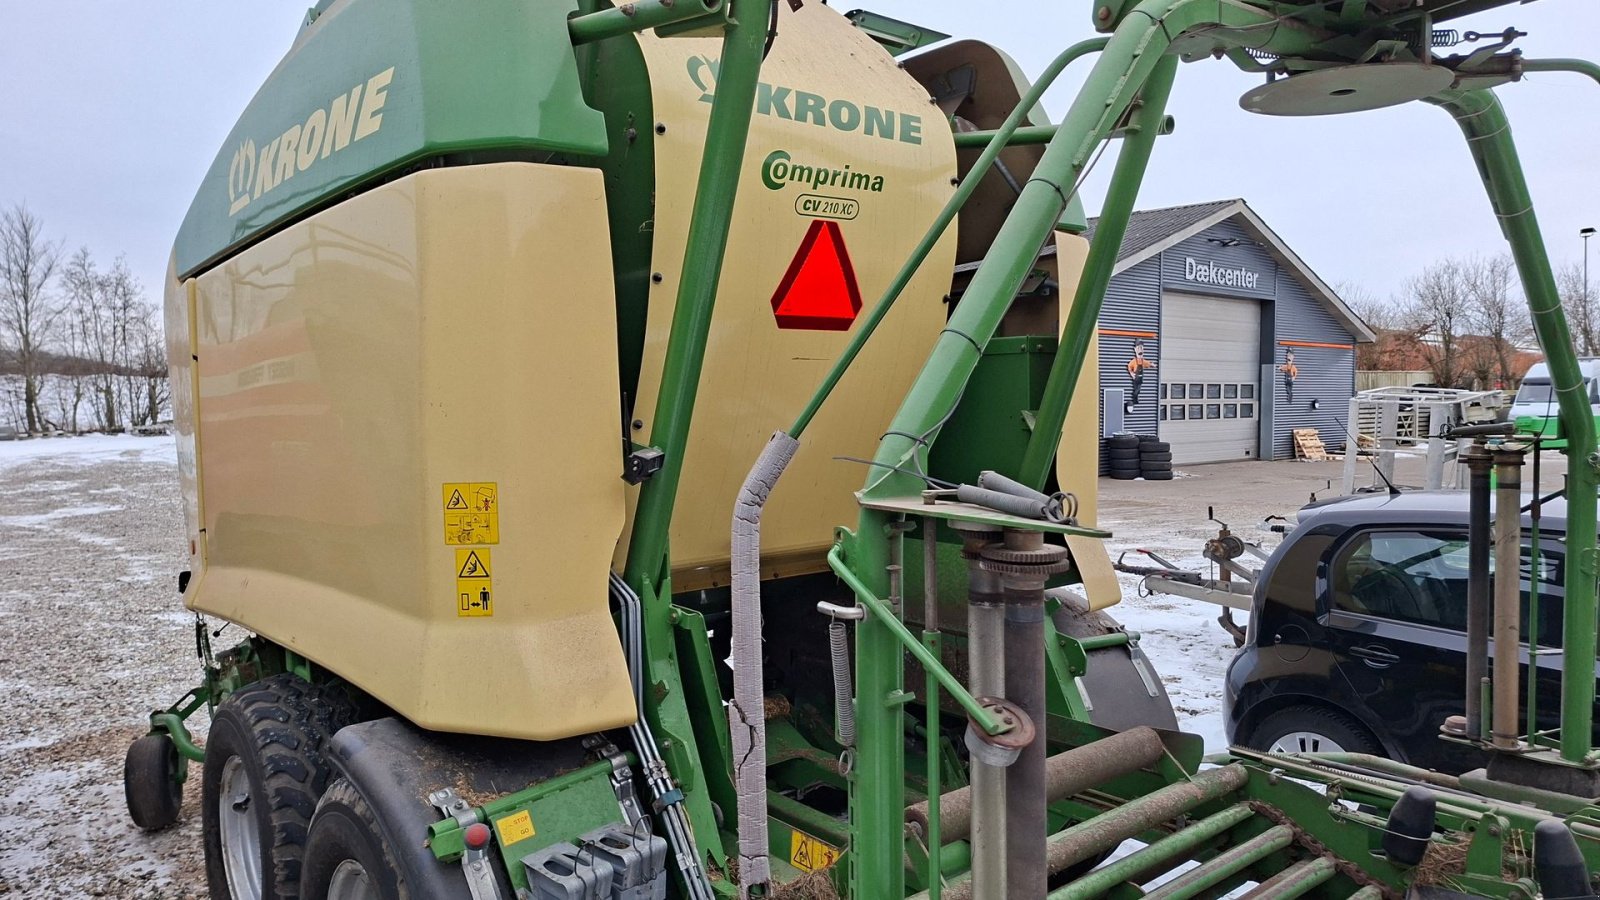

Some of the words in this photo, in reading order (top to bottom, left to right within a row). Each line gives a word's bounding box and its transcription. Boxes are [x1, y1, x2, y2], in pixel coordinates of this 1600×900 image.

[756, 82, 922, 145] KRONE
[253, 66, 395, 200] KRONE
[761, 150, 884, 192] Comprima
[803, 199, 821, 212] CV
[822, 201, 839, 214] 210
[840, 203, 854, 215] XC
[1185, 257, 1259, 288] Dækcenter
[513, 815, 529, 825] STOP
[520, 827, 530, 835] GO
